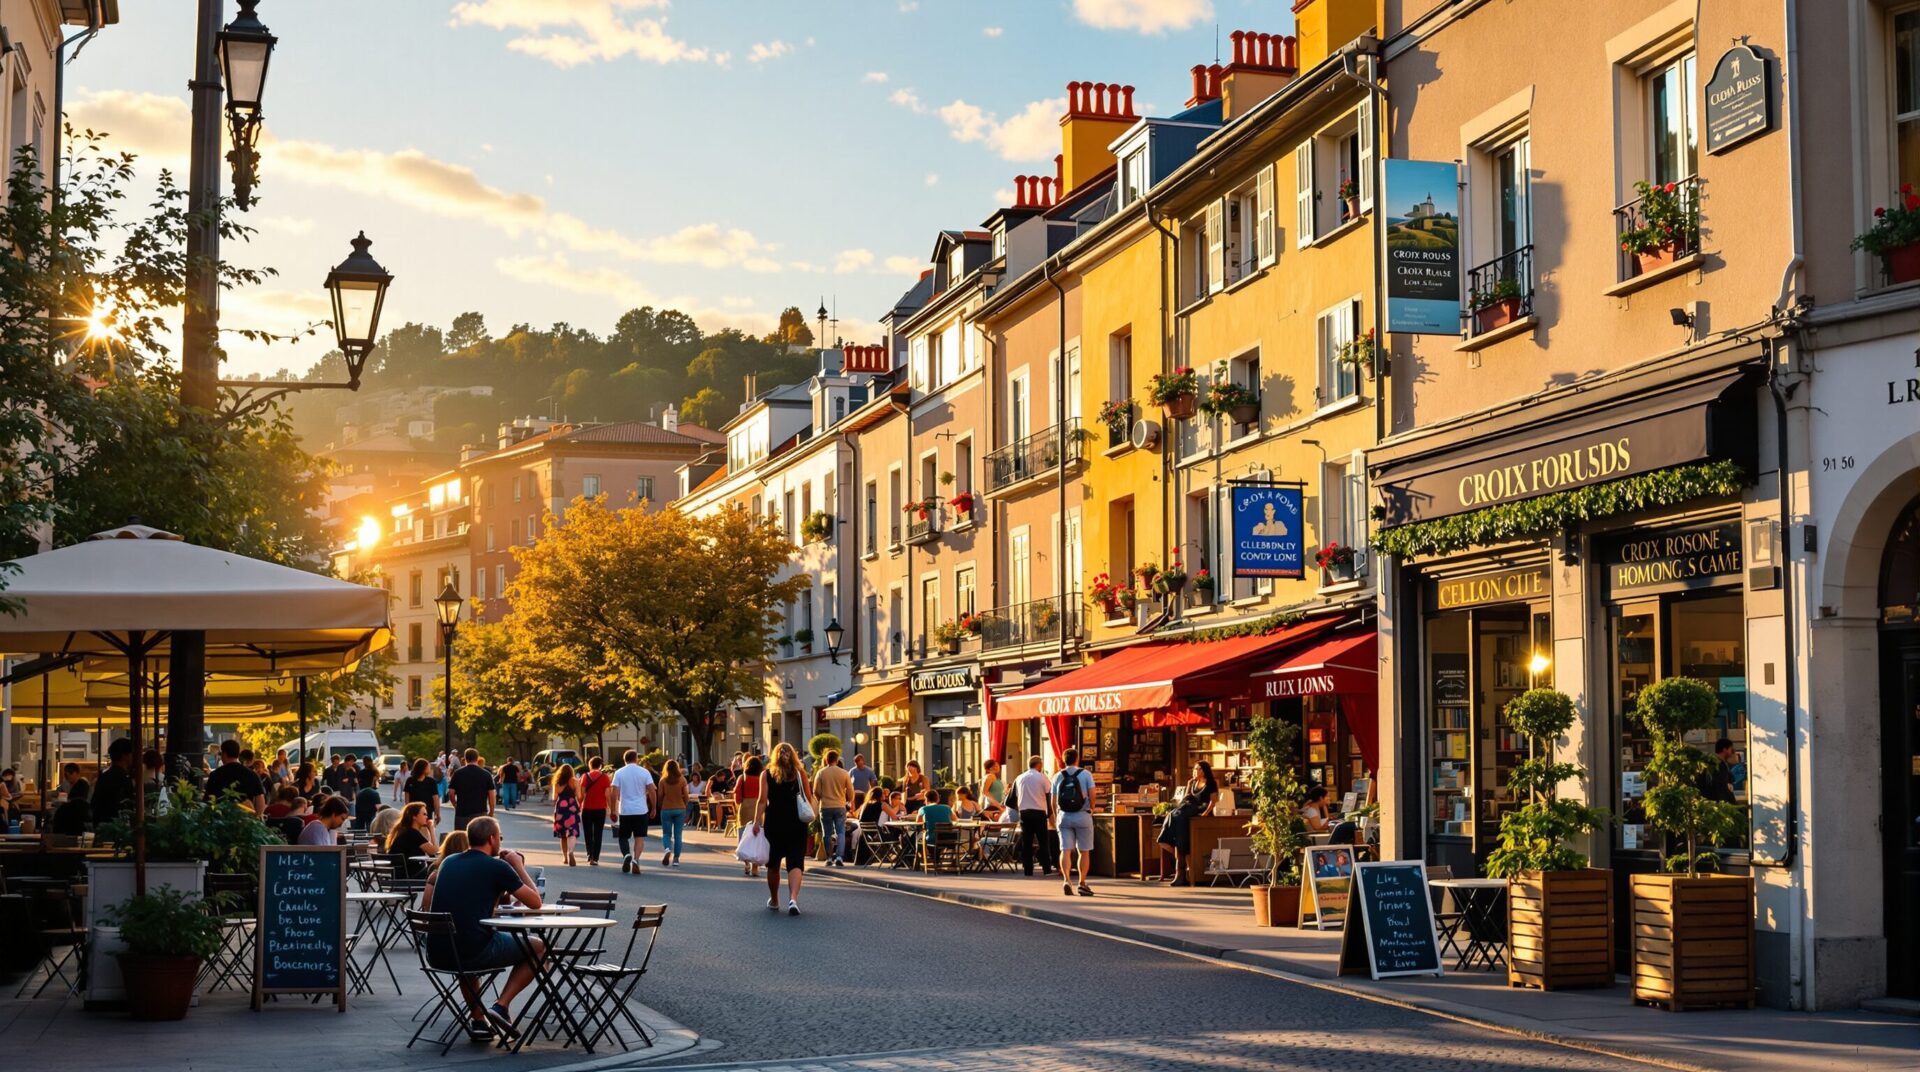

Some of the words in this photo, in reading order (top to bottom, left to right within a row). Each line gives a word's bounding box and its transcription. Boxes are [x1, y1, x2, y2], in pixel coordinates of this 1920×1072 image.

[1393, 250, 1420, 259] CROIX
[1458, 463, 1528, 507] CROIX
[1621, 539, 1660, 563] CROIX
[1666, 529, 1720, 557] ROSONE
[1440, 576, 1502, 607] CELLON
[1039, 696, 1071, 715] CROIX
